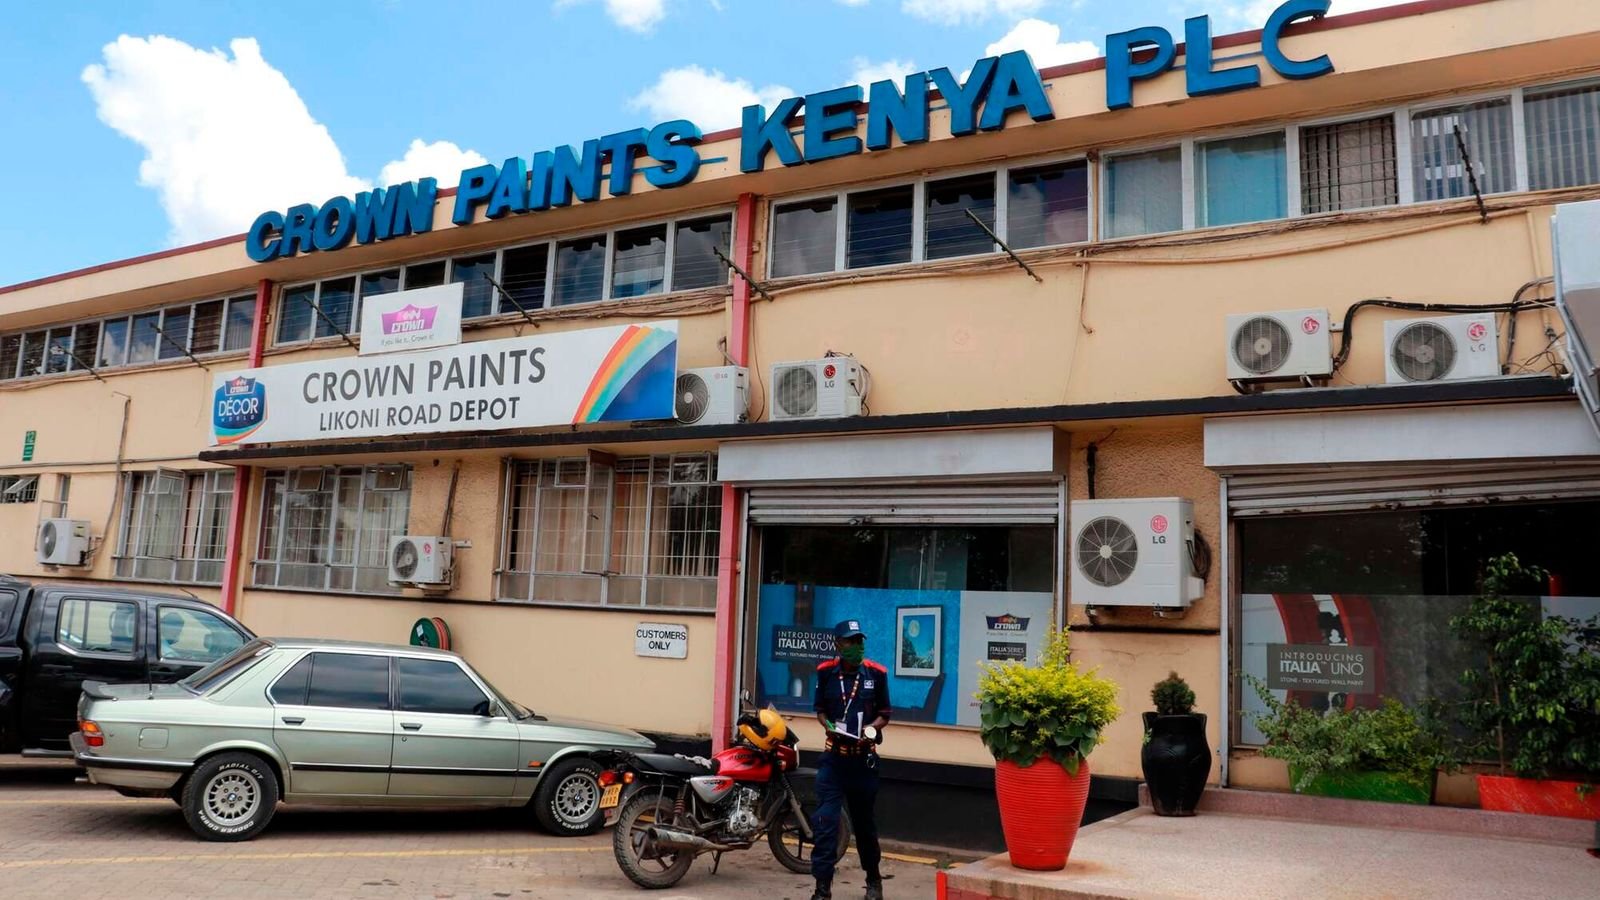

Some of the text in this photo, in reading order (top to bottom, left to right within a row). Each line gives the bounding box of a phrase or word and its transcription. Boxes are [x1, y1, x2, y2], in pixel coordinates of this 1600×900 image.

[246, 0, 1334, 263] CROWN PAINTS KENYA PLC
[303, 347, 546, 404] CROWN PAINTS
[824, 380, 834, 388] LG
[218, 397, 259, 416] DÉCOR
[319, 397, 520, 431] LIKONI ROAD DEPOT
[1152, 535, 1166, 544] LG
[636, 629, 686, 640] CUSTOMERS
[648, 640, 671, 650] ONLY
[1280, 652, 1364, 662] INTRODUCING
[1331, 662, 1364, 676] UNO
